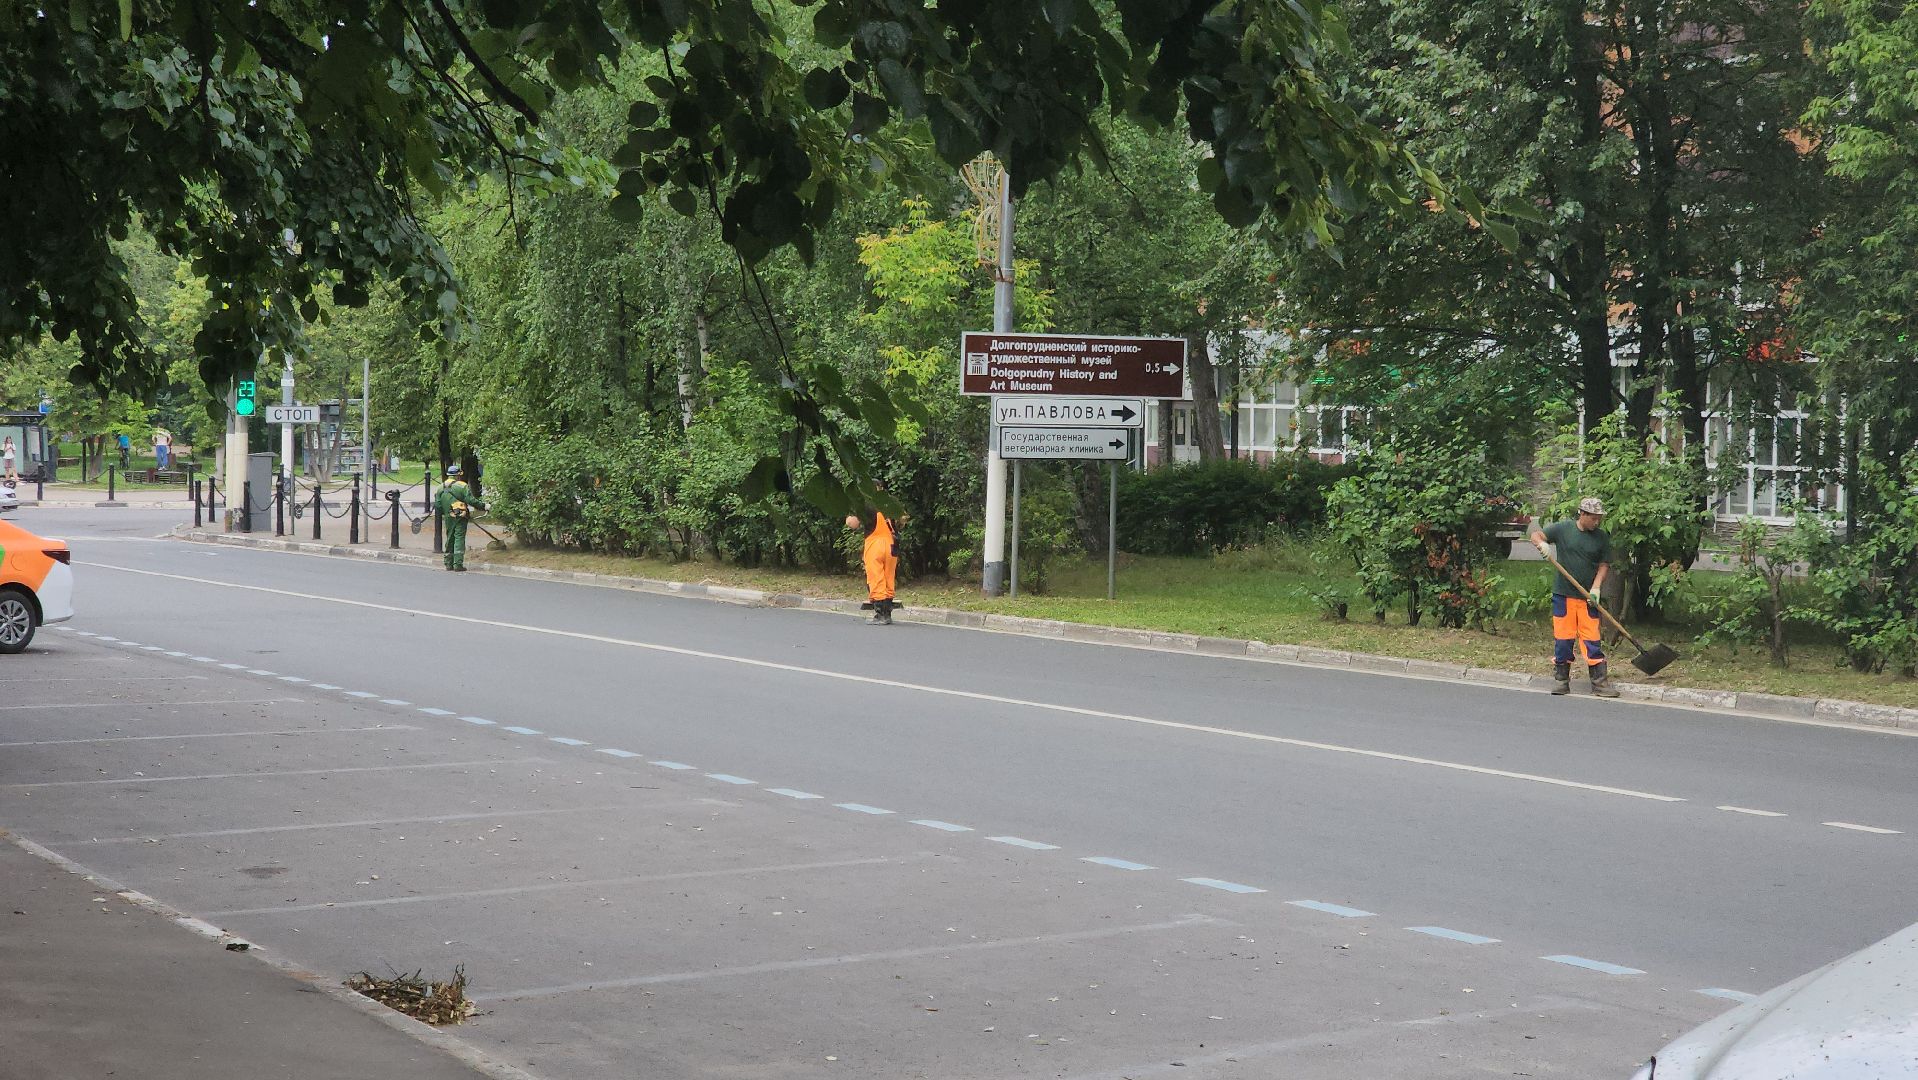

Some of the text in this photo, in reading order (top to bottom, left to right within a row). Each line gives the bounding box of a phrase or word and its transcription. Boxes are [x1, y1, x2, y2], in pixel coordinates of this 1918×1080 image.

[990, 339, 1142, 354] Долгопрудненский историко-
[990, 354, 1112, 367] художественный музей
[990, 368, 1118, 381] Dolgoprudny History and
[1145, 363, 1160, 375] 0,5
[239, 381, 254, 397] 23
[990, 381, 1053, 391] Art Museum
[274, 409, 312, 420] СТОП
[1000, 405, 1106, 421] ул. ПАВЛОВА
[1004, 432, 1089, 444] Государственная
[1005, 444, 1104, 455] ветеринарная клиника
